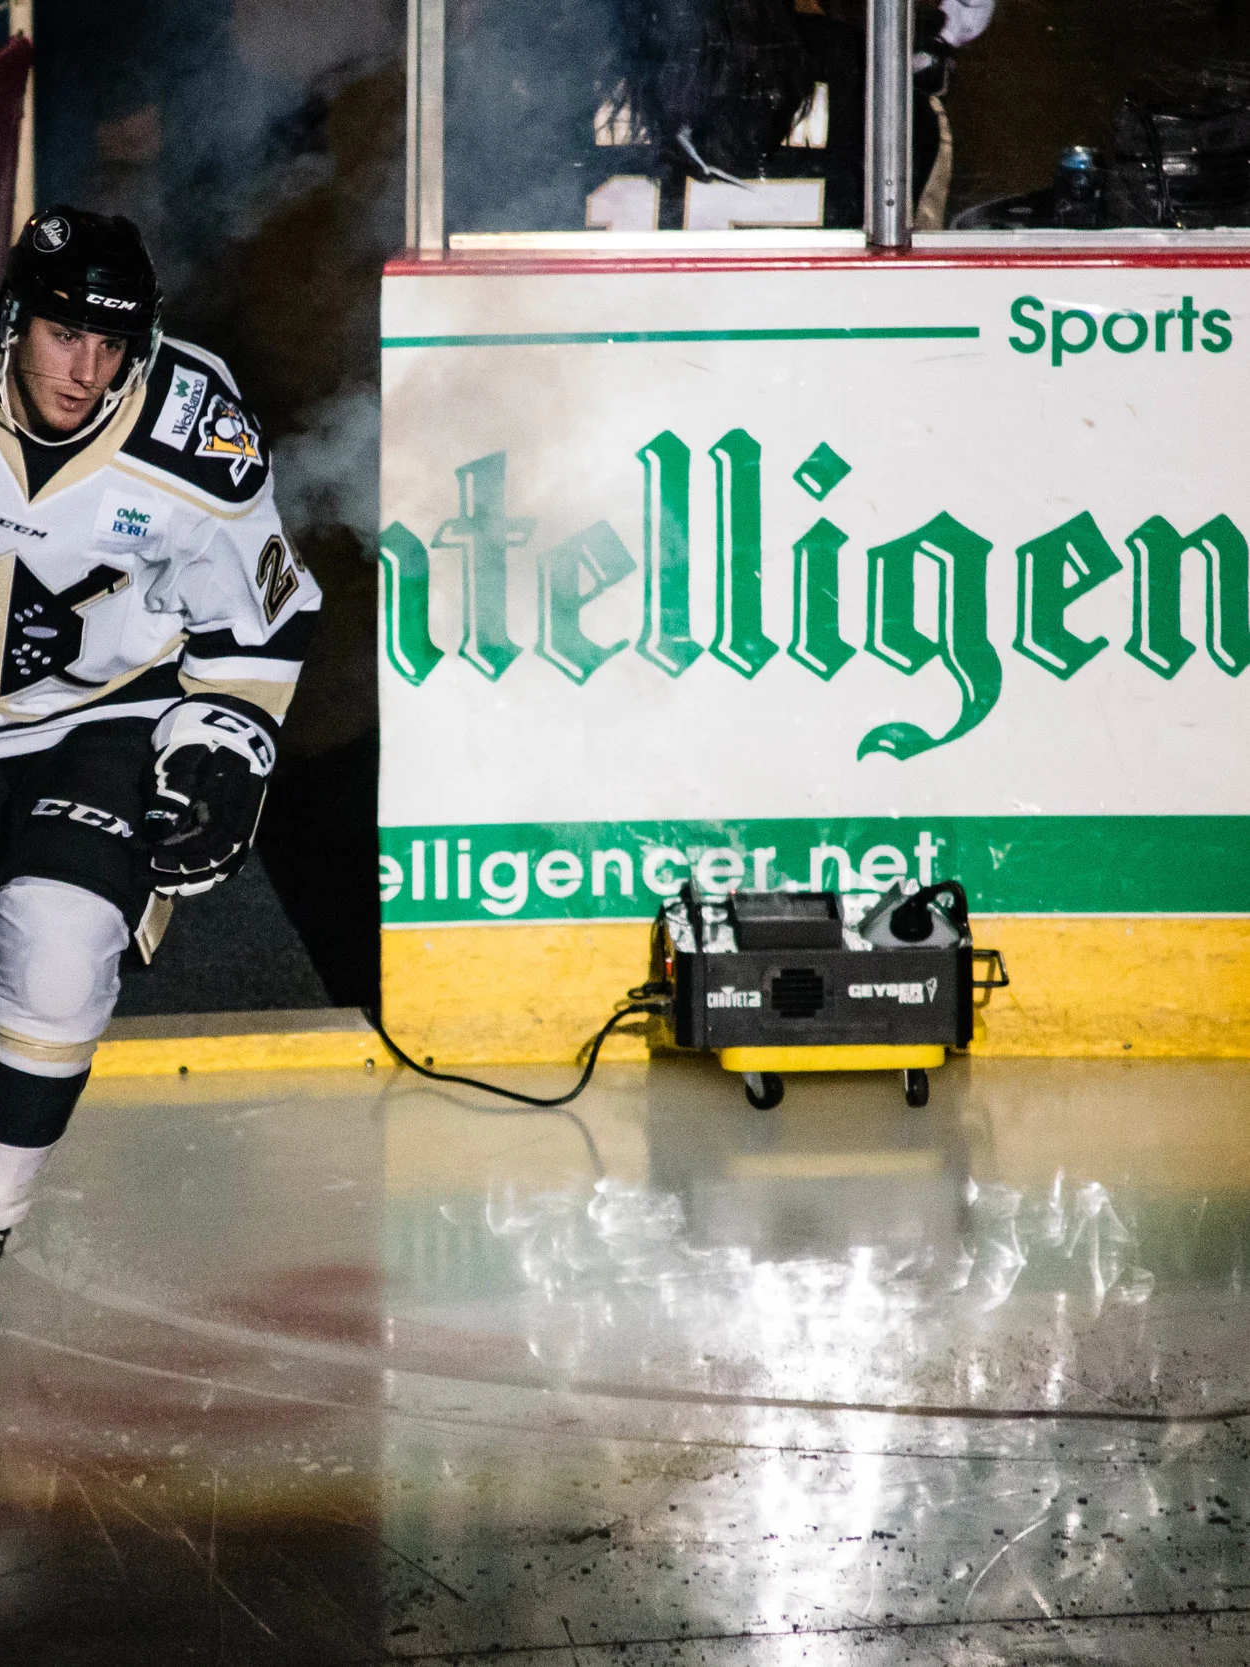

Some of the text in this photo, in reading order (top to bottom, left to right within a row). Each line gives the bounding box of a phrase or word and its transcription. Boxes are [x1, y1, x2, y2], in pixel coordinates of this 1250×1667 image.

[85, 293, 137, 311] CCM
[1008, 295, 1233, 367] Sports
[171, 378, 205, 436] WesBanco
[255, 533, 306, 626] 2
[200, 709, 273, 769] CC
